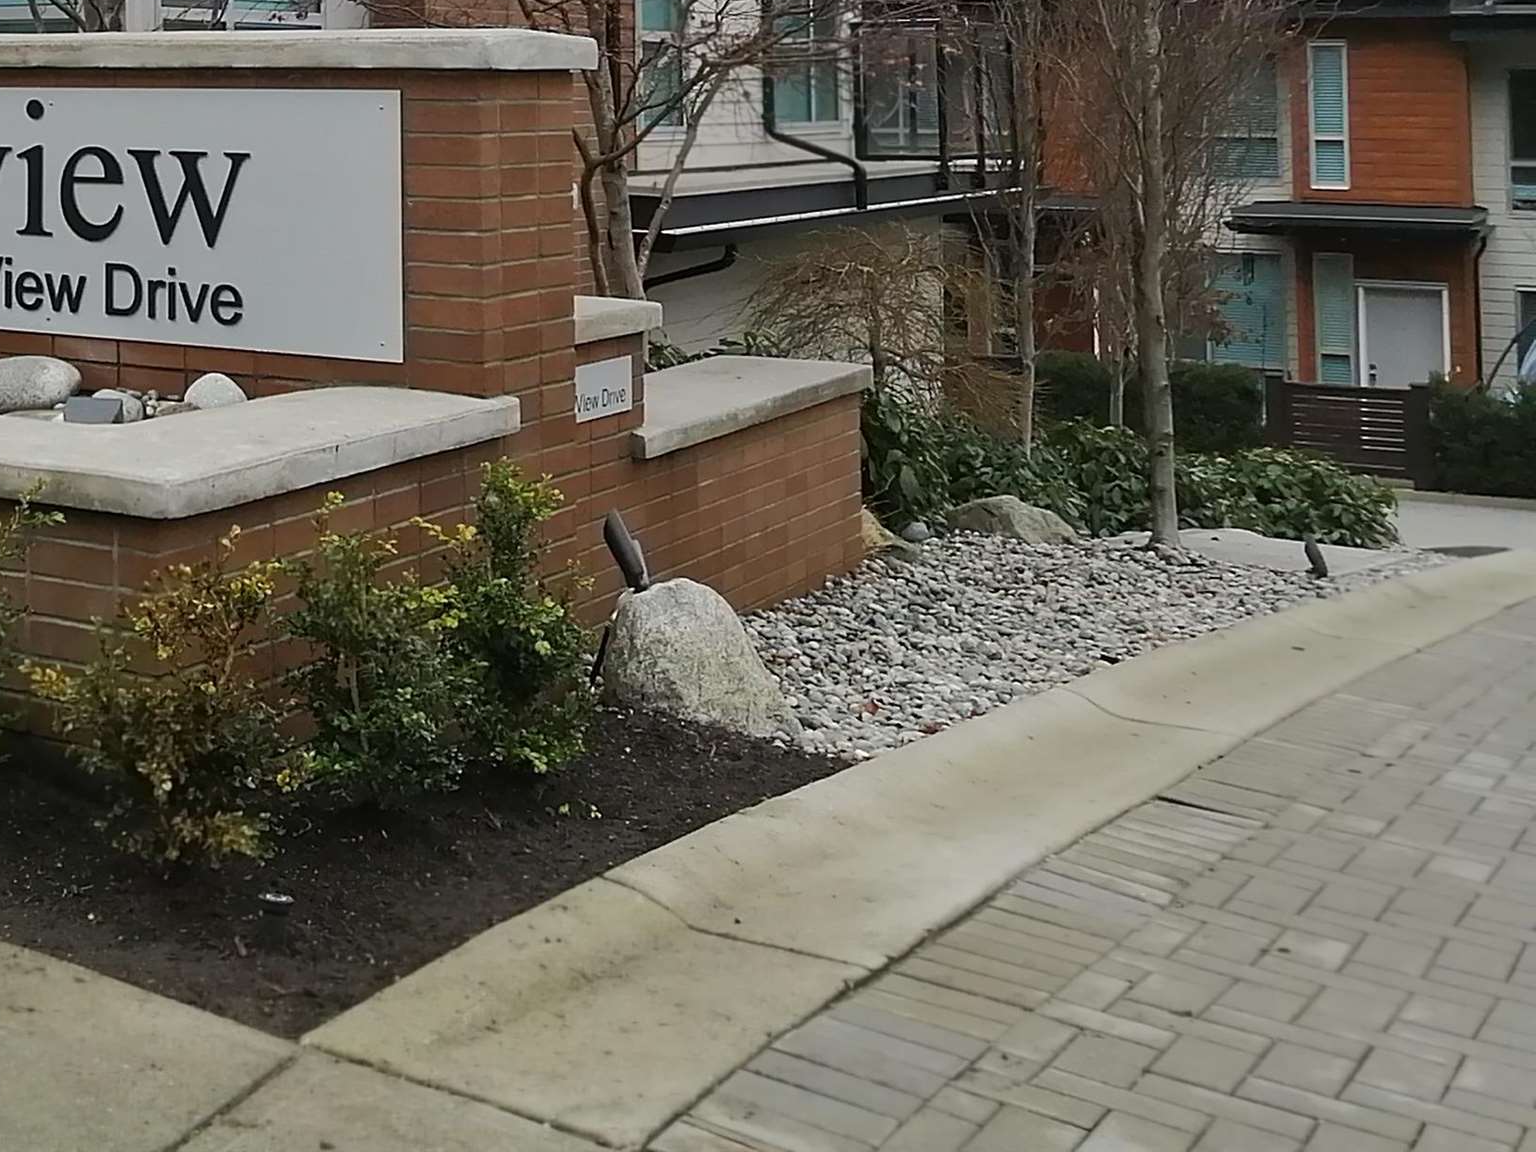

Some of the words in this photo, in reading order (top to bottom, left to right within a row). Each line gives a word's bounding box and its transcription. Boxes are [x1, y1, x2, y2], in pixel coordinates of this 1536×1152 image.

[104, 262, 244, 327] Drive
[575, 393, 600, 414] View
[601, 388, 626, 408] Drive
